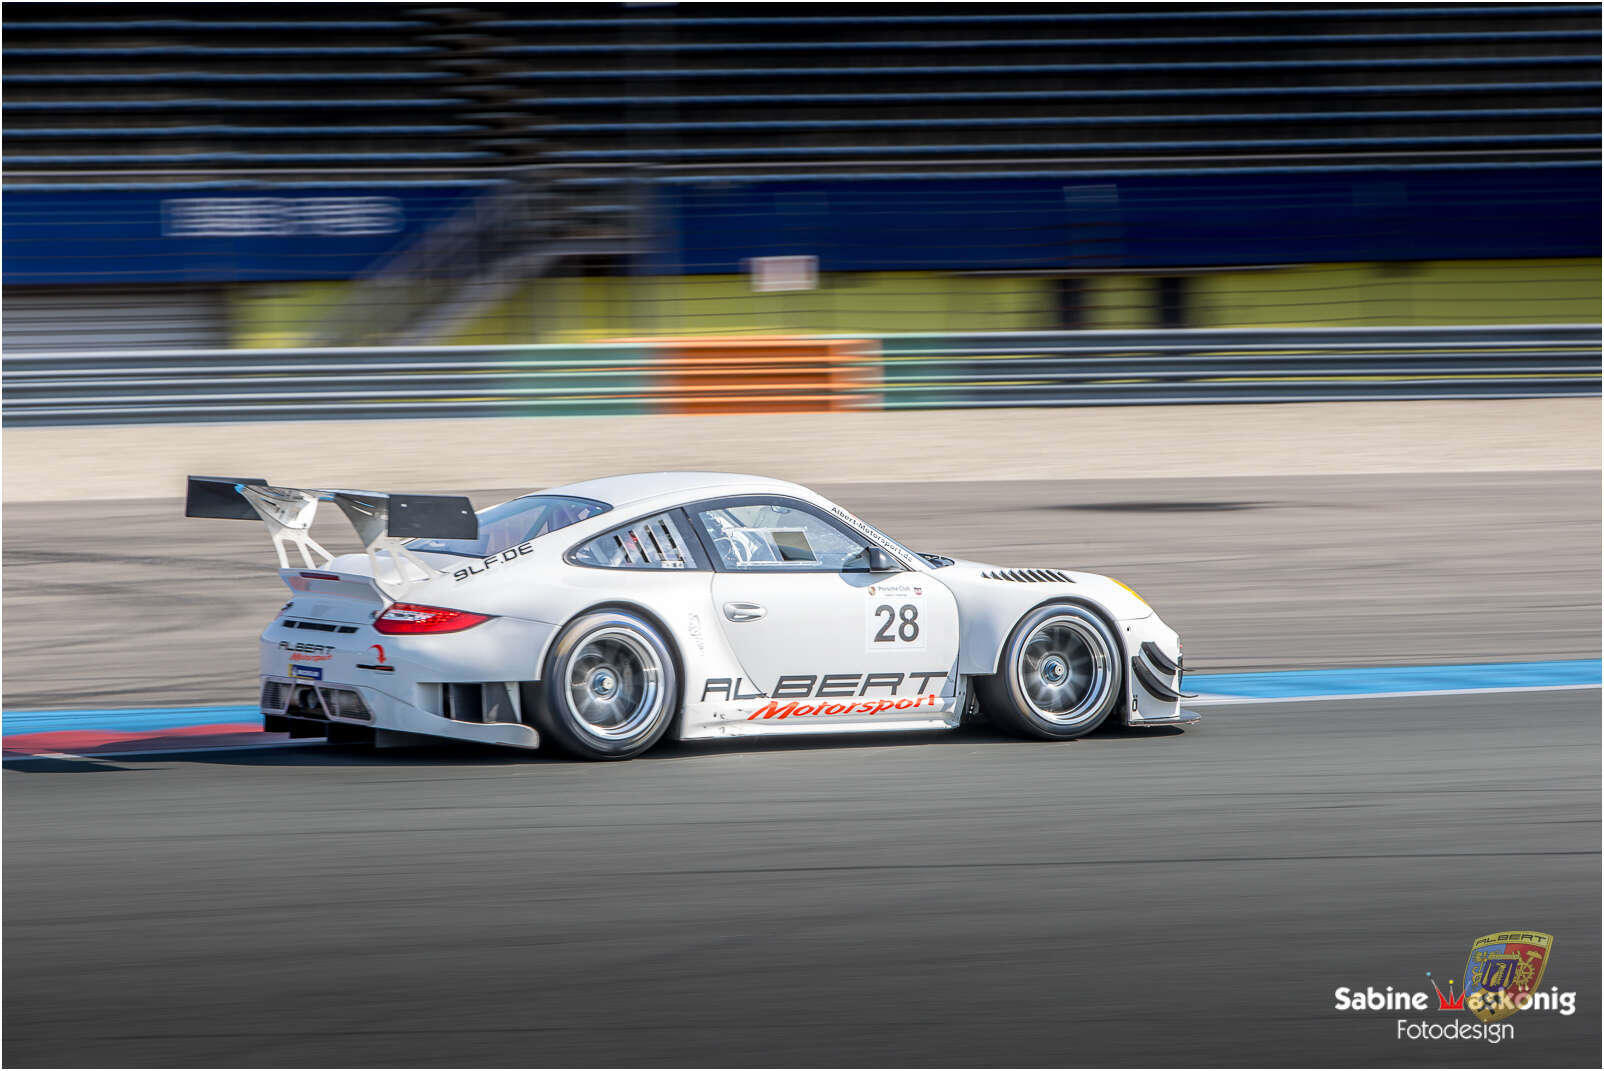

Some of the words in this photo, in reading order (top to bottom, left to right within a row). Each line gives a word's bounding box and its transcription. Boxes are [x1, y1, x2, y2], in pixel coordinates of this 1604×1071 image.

[454, 542, 534, 581] 9LF.DE
[873, 604, 920, 642] 28
[279, 640, 336, 655] ALBERT
[701, 671, 949, 702] ALBERT
[747, 694, 936, 720] Motorsport
